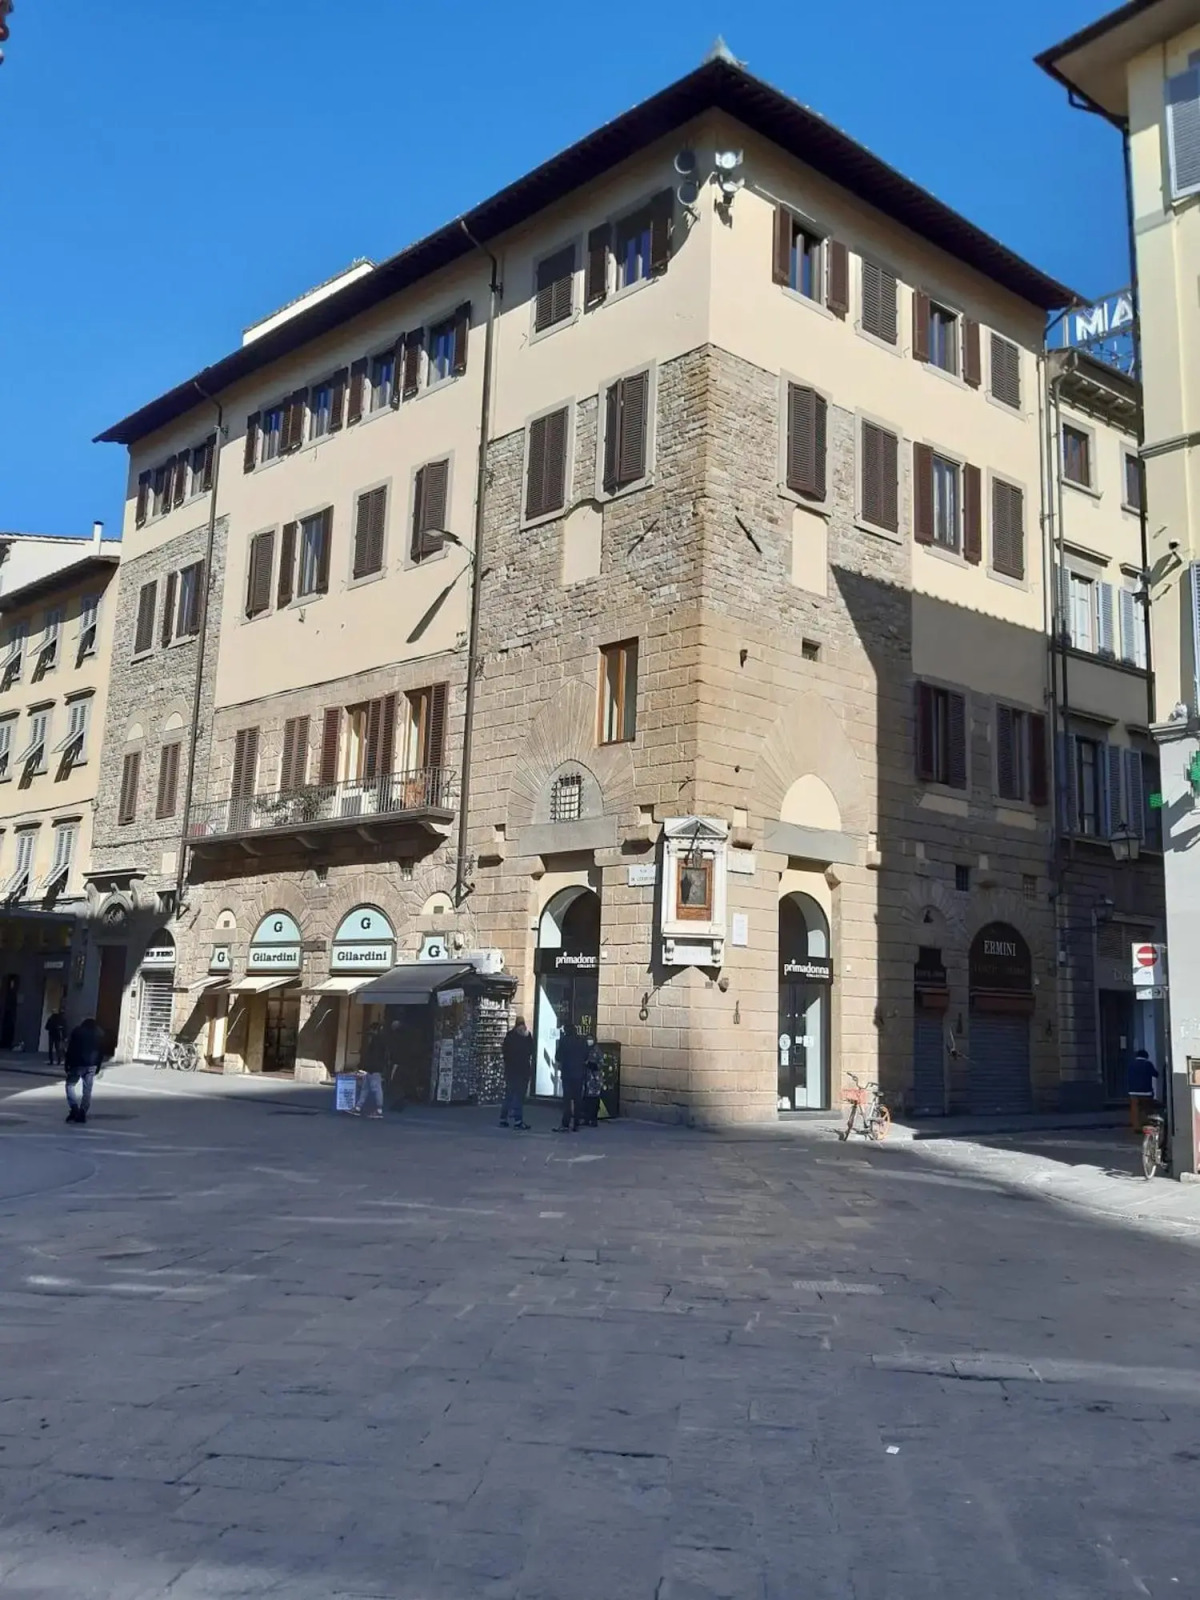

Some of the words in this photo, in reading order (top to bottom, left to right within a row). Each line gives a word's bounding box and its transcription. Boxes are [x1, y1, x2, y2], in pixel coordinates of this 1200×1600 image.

[274, 921, 283, 933] G
[361, 917, 371, 930] G
[428, 945, 441, 958] G
[984, 940, 1016, 957] ERMINI
[217, 951, 226, 963] G
[252, 952, 297, 962] Gilardini
[337, 951, 387, 962] Gilardini
[784, 958, 829, 976] primadonna
